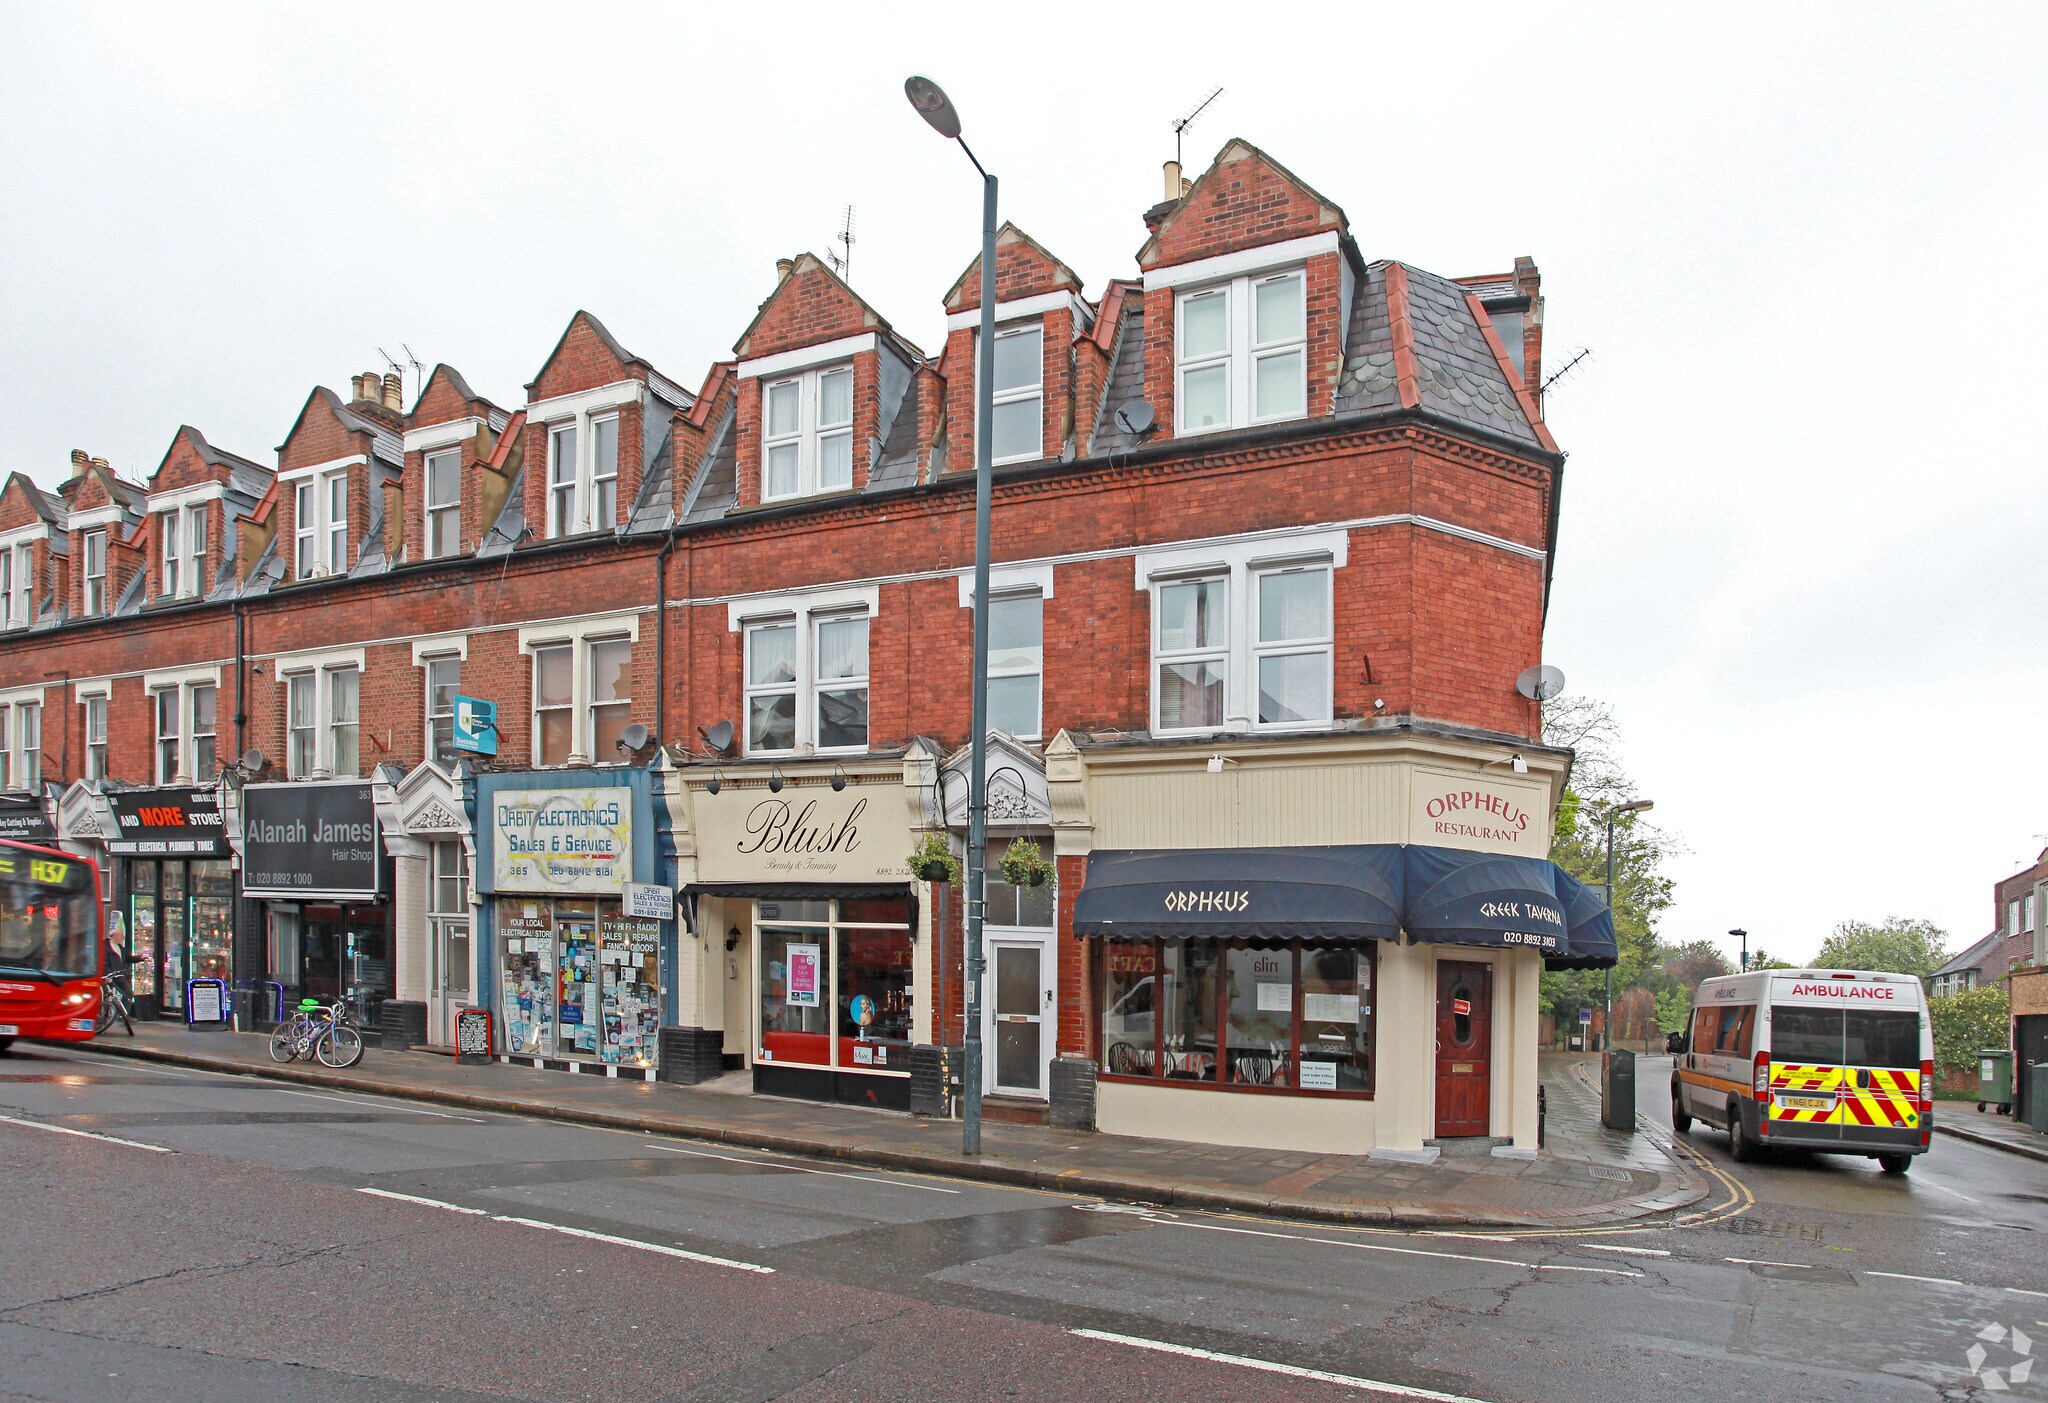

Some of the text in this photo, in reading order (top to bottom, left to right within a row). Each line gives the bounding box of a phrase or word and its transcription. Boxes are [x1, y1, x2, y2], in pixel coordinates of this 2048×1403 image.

[456, 737, 478, 746] Success
[120, 807, 222, 826] AND MORE STORE
[499, 803, 618, 826] ORBIT ELECTRONICS
[1426, 792, 1530, 830] ORPHEUS
[247, 818, 372, 843] Alanah James
[737, 798, 868, 854] Blush
[1435, 822, 1520, 842] RESTAURANT
[110, 841, 213, 852] HARDWARE ELECTRICAL PLUMBING TOOLS
[552, 836, 560, 851] &
[332, 849, 372, 863] Hair Shop
[596, 867, 612, 876] 8181
[764, 858, 837, 874] Beauty & Tanning
[248, 873, 312, 884] T: 020 8892 1000
[633, 893, 671, 902] ELECTRONICS
[1164, 891, 1249, 911] ORPHEUS
[1480, 902, 1562, 927] GREEK TAVERNA
[633, 934, 658, 942] REPAIRS
[1504, 932, 1556, 947] 020 8892 3103
[630, 944, 654, 952] GOODS
[1792, 984, 1894, 999] AMBULANCE
[1787, 1098, 1806, 1107] YN61
